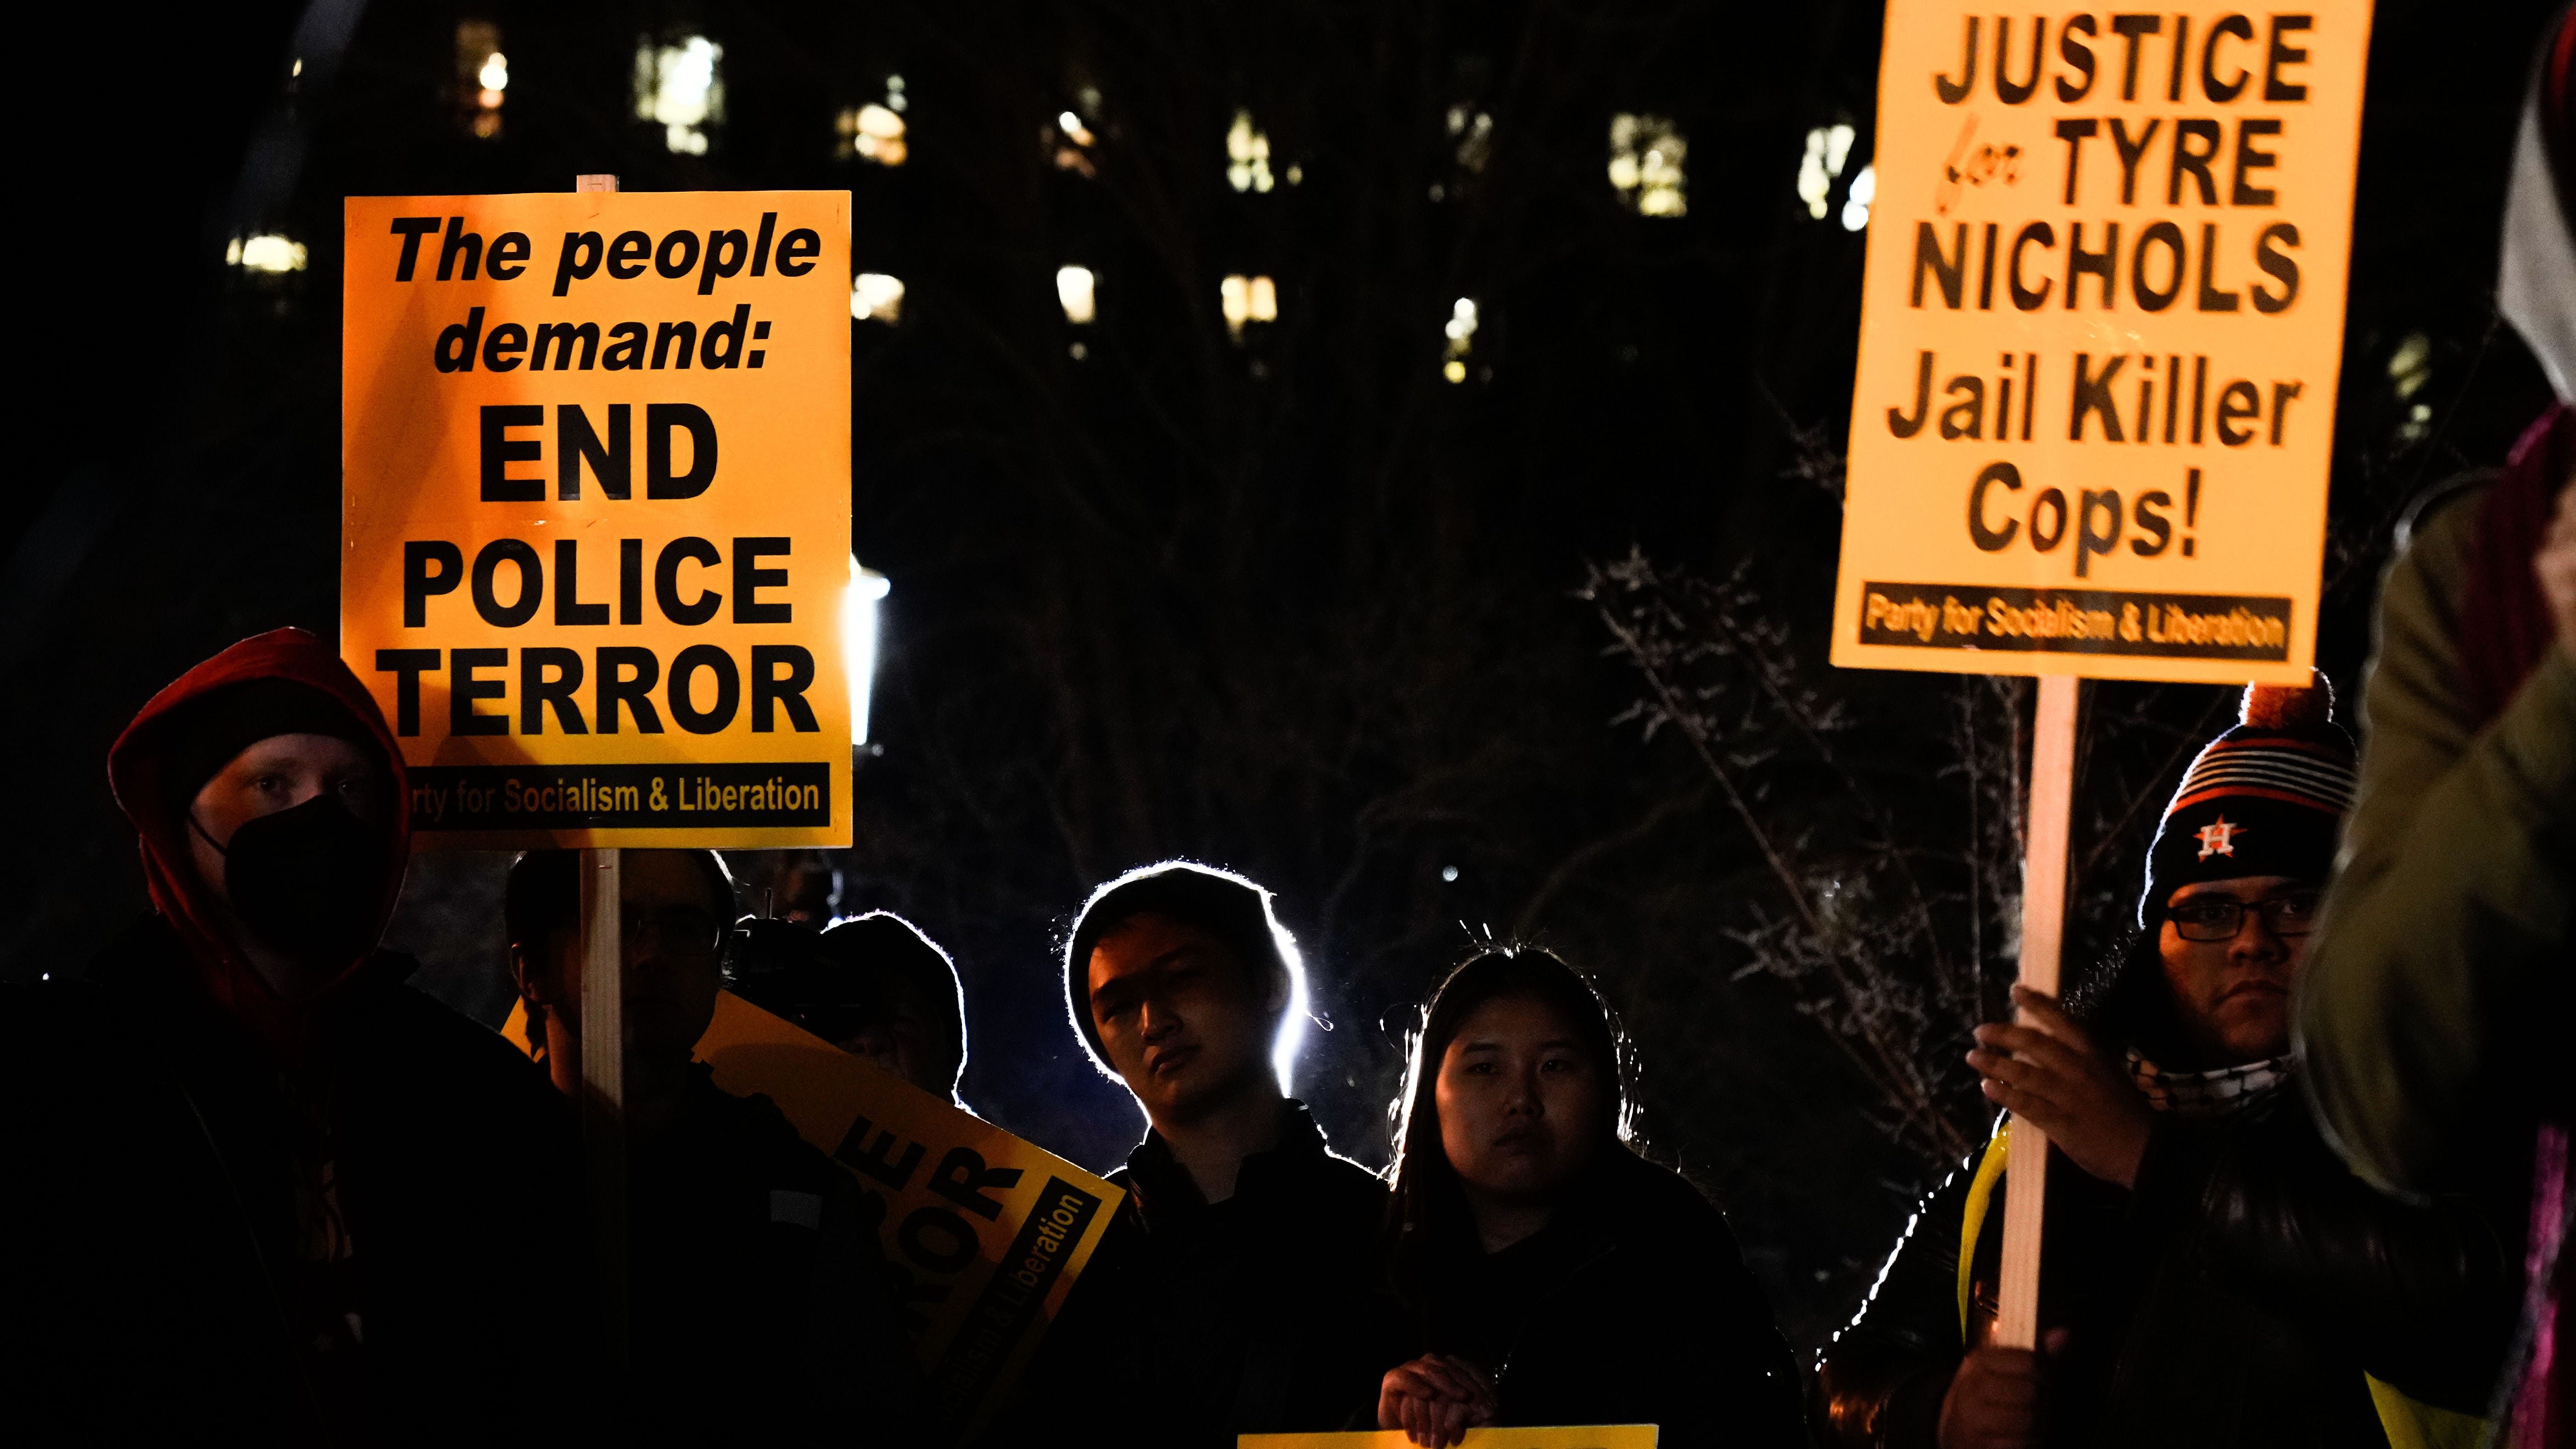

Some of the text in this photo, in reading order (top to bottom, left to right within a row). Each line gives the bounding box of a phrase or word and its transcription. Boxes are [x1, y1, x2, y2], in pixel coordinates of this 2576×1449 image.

[1935, 13, 2313, 105] JUSTICE
[1934, 112, 2282, 216] for TYRE
[390, 212, 821, 297] The people
[1910, 221, 2300, 314] NICHOLS
[433, 304, 771, 374] demand:
[1887, 351, 2302, 446] Jail Killer
[480, 403, 718, 502] END
[1968, 461, 2201, 578] Cops!
[403, 536, 792, 628] POLICE
[1866, 592, 2284, 648] Party for Socialism & Liberation
[376, 644, 820, 737] TERROR
[412, 776, 820, 823] rty for Socialism & Liberation
[2197, 822, 2240, 857] H
[938, 1192, 1085, 1423] ocialism & Liberation
